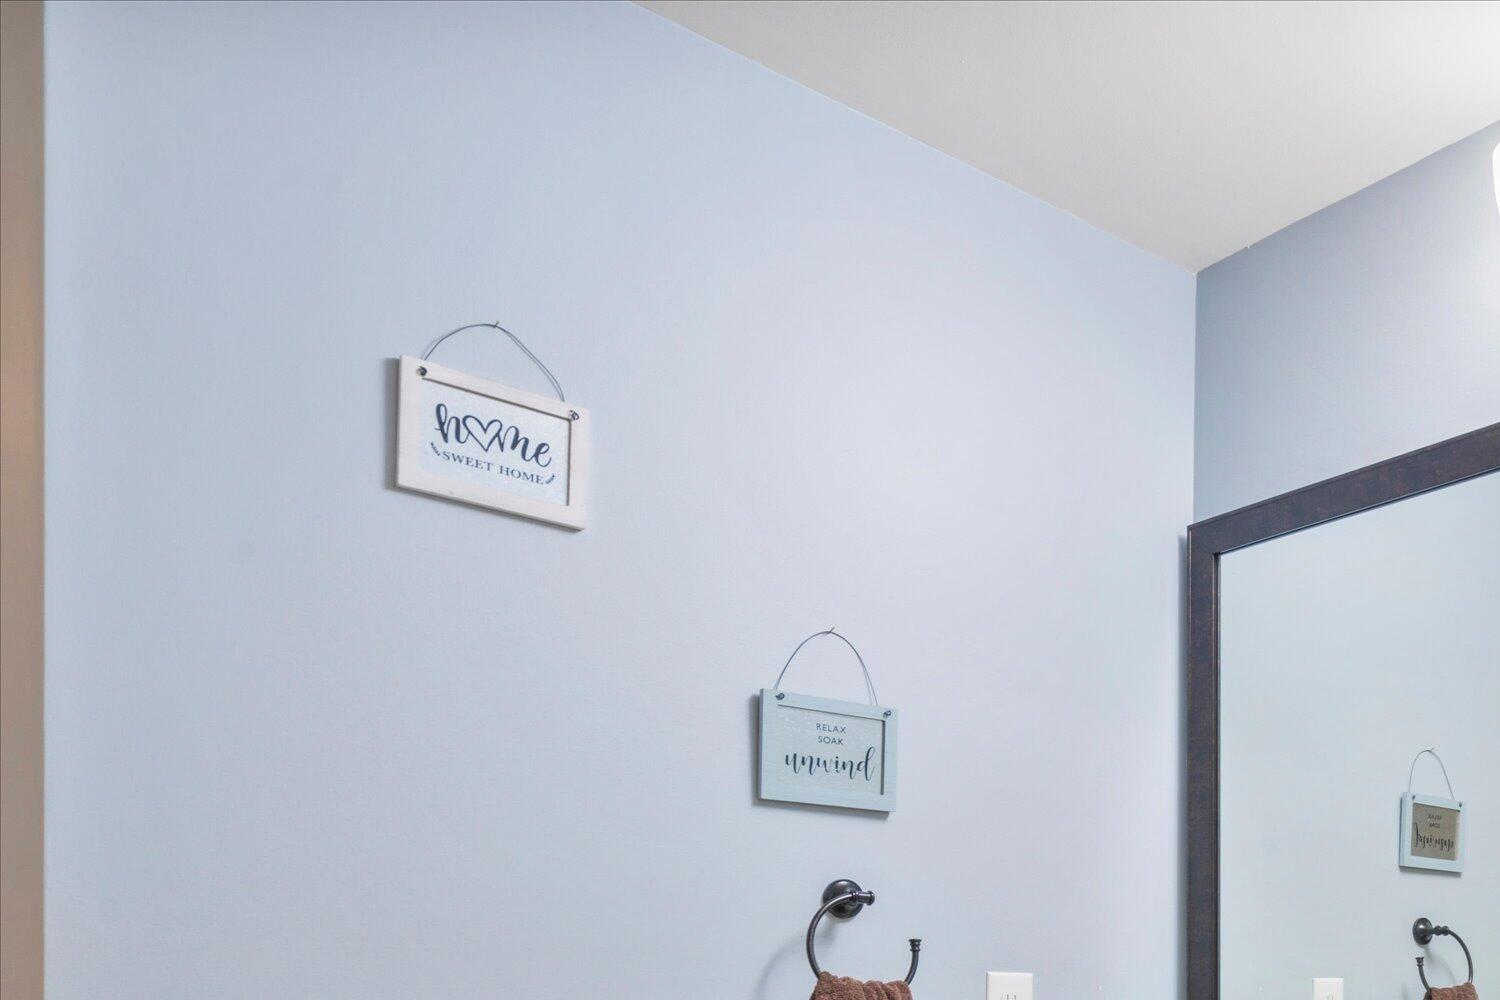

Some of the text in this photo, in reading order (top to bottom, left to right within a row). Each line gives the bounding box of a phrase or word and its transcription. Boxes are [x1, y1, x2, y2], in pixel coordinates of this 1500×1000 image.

[435, 403, 552, 468] home
[442, 451, 544, 485] SWEET HOME
[816, 722, 847, 734] RELAX
[818, 735, 844, 746] SOAK
[785, 746, 876, 781] unwind
